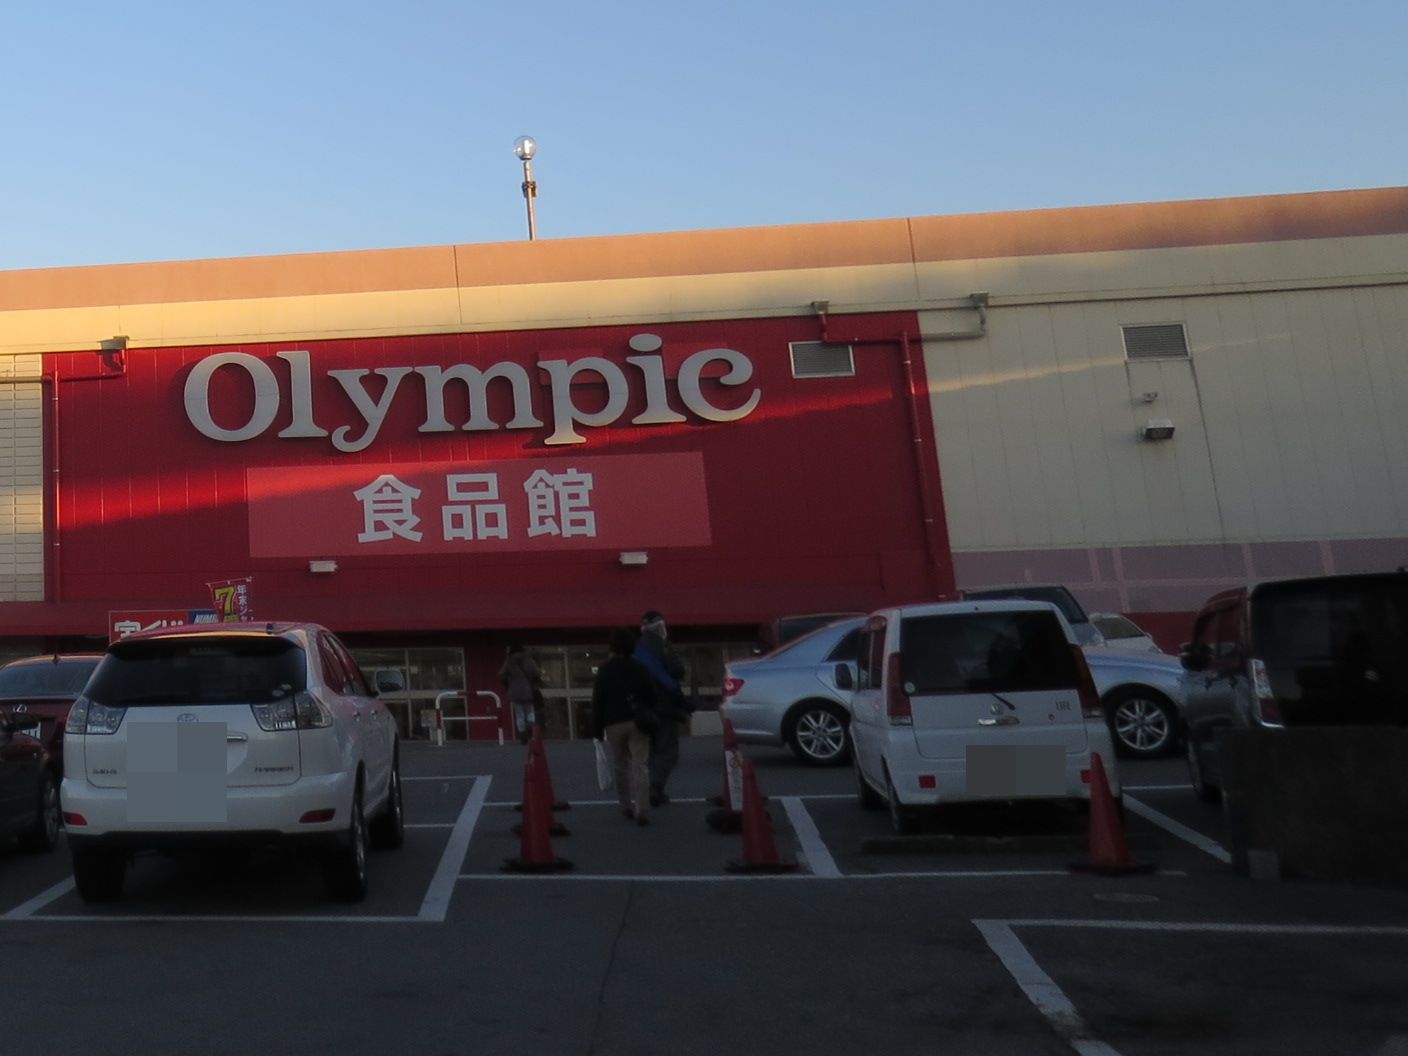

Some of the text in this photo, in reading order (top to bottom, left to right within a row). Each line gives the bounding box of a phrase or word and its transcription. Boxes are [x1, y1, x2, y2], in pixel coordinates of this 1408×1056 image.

[183, 333, 762, 453] Olympic
[352, 467, 598, 544] 食品館
